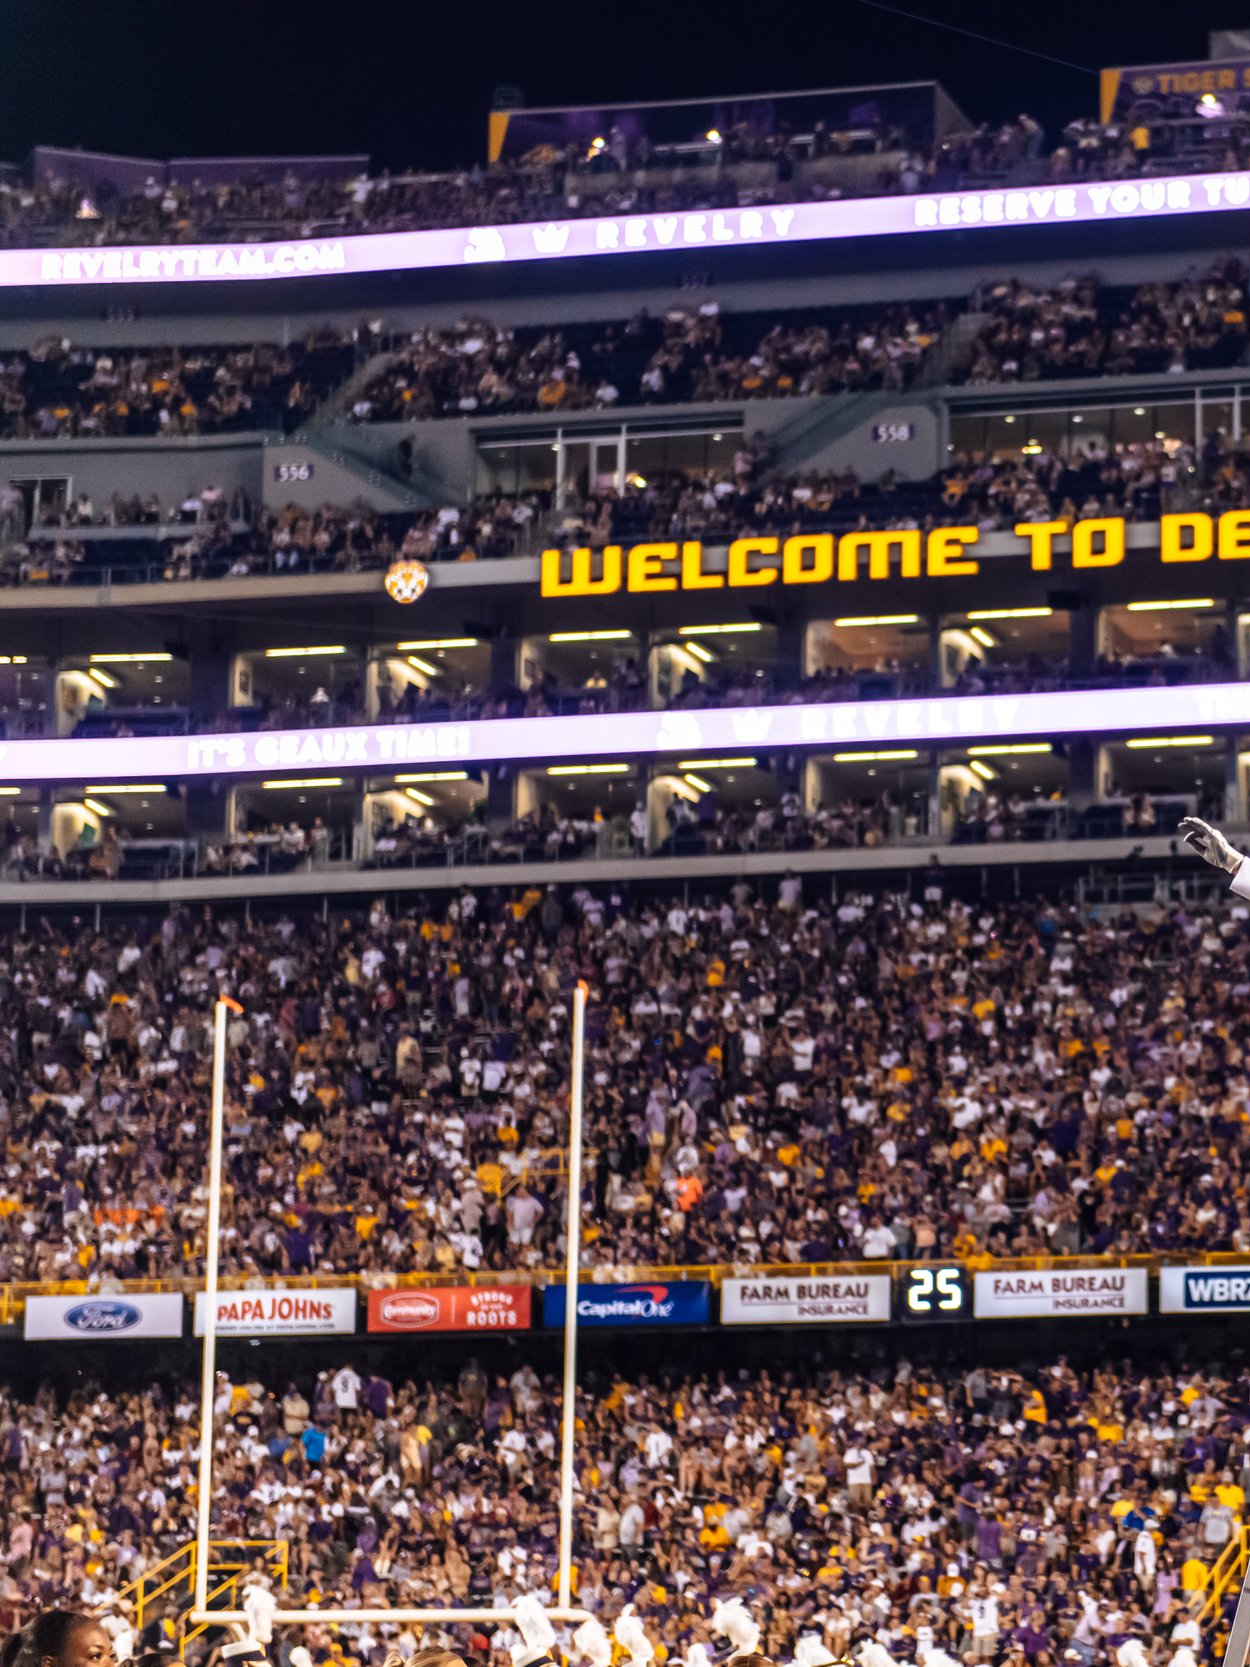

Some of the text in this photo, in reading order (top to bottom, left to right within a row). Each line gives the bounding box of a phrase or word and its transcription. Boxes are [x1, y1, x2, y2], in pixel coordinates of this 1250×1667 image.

[1157, 69, 1235, 95] TIGER
[915, 189, 1076, 227] RESERVE
[1087, 180, 1191, 214] YOUR
[596, 209, 795, 249] REVELRY
[41, 242, 345, 280] REVELRYTEAM.COM
[878, 423, 910, 442] 558
[279, 464, 310, 482] 556
[541, 526, 979, 598] WELCOME
[1014, 517, 1125, 570] TO
[801, 698, 1019, 740] REVELRY
[254, 733, 368, 765] GEAUX
[376, 727, 470, 759] TIME!
[740, 1281, 870, 1300] FARM BUREAU
[908, 1268, 962, 1311] 25
[993, 1275, 1126, 1295] FARM BUREAU
[217, 1297, 333, 1321] PAPA JOHNS
[383, 1303, 438, 1320] Community
[797, 1303, 870, 1317] INSURANCE
[1053, 1296, 1126, 1310] INSURANCE
[76, 1307, 128, 1330] Ford
[466, 1310, 518, 1326] ROOTS
